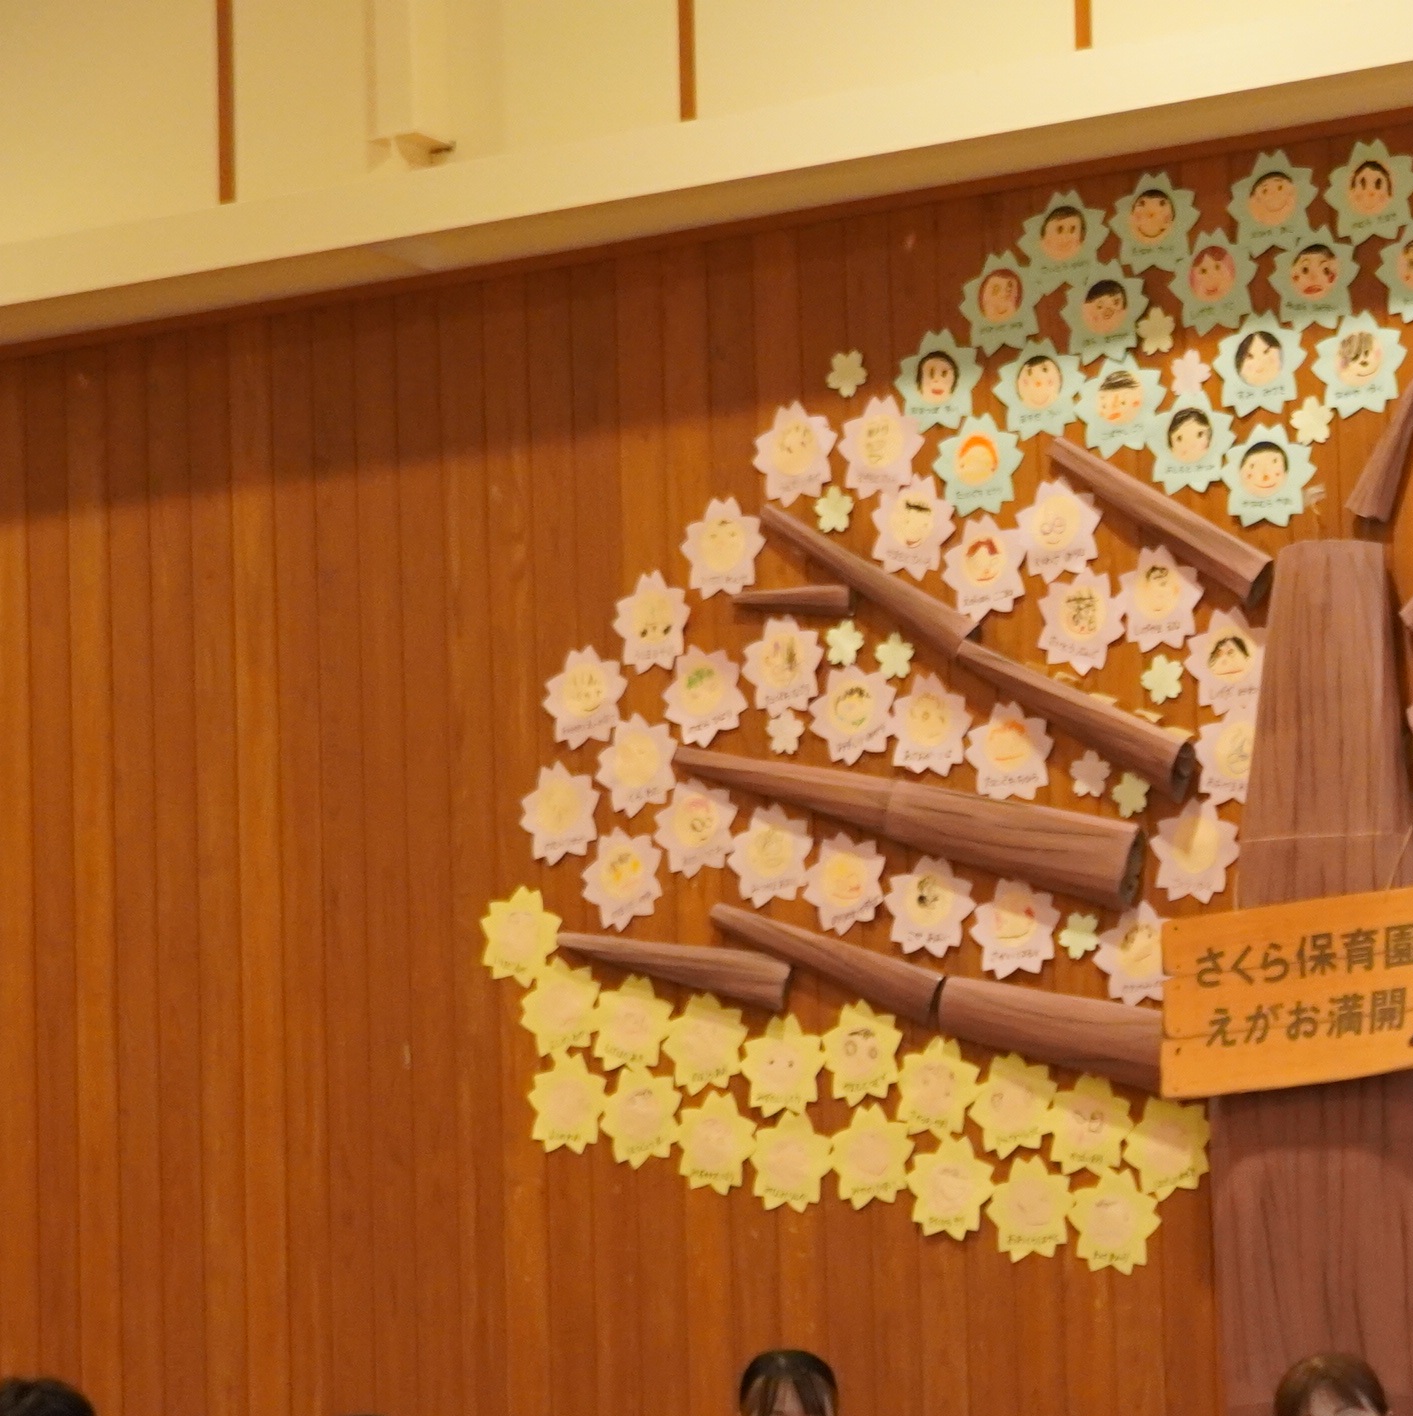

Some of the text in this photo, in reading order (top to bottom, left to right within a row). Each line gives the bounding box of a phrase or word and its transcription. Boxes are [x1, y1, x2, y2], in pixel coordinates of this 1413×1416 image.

[1206, 987, 1407, 1048] えがお満開
